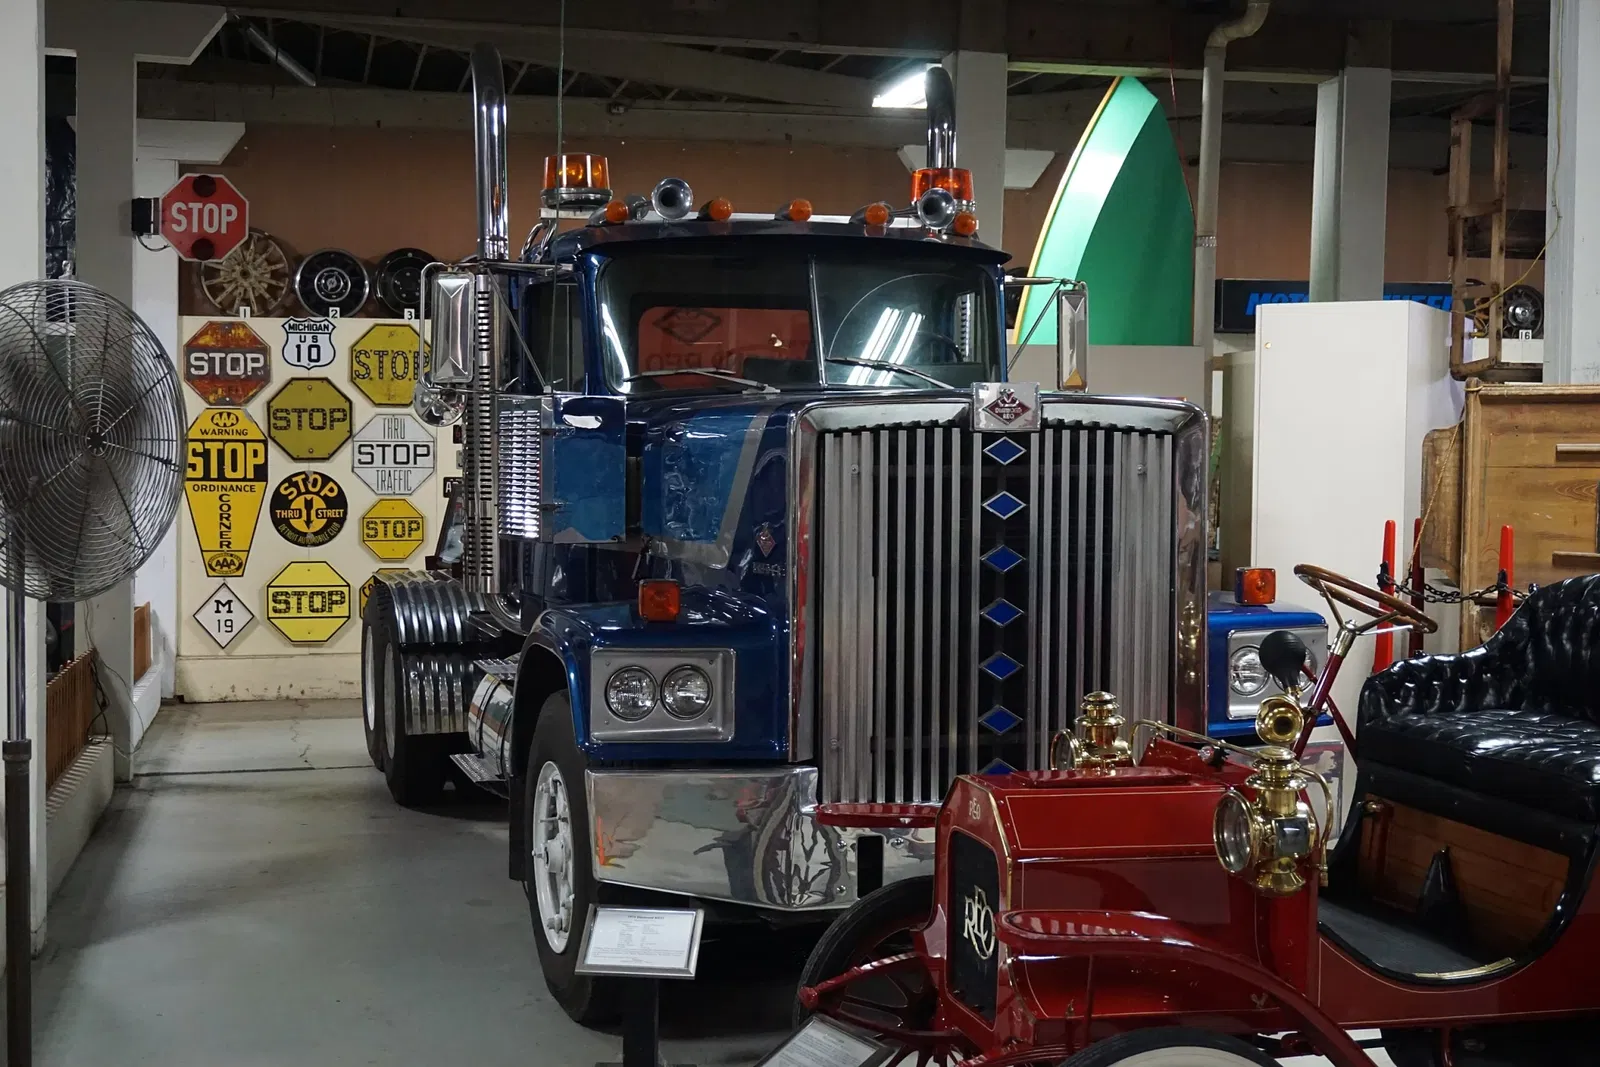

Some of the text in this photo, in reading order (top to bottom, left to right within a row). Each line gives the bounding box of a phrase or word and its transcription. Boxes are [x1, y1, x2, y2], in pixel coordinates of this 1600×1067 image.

[171, 202, 238, 234] STOP
[331, 309, 338, 318] 2
[407, 311, 413, 320] 3
[288, 323, 330, 332] MICHIGAN
[1520, 331, 1531, 340] 16
[295, 344, 321, 363] 10
[189, 352, 265, 375] STOP
[354, 349, 430, 380] STOP
[213, 412, 238, 427] AAA
[272, 408, 347, 430] STOP
[199, 428, 249, 436] WARNING
[382, 418, 406, 440] THRU
[187, 441, 265, 479] STOP
[357, 444, 431, 465] STOP
[192, 484, 257, 493] ORDINANCE
[279, 473, 339, 500] STOP
[376, 469, 412, 491] TRAFFIC
[218, 493, 232, 549] CORNER
[275, 509, 344, 518] THRU STREET
[278, 523, 299, 541] DETROIT
[328, 521, 341, 536] CLUB
[365, 520, 421, 539] STOP
[215, 557, 237, 569] AAA
[214, 600, 233, 613] M
[271, 590, 346, 614] STOP
[216, 619, 233, 633] 19
[963, 885, 995, 960] REO
